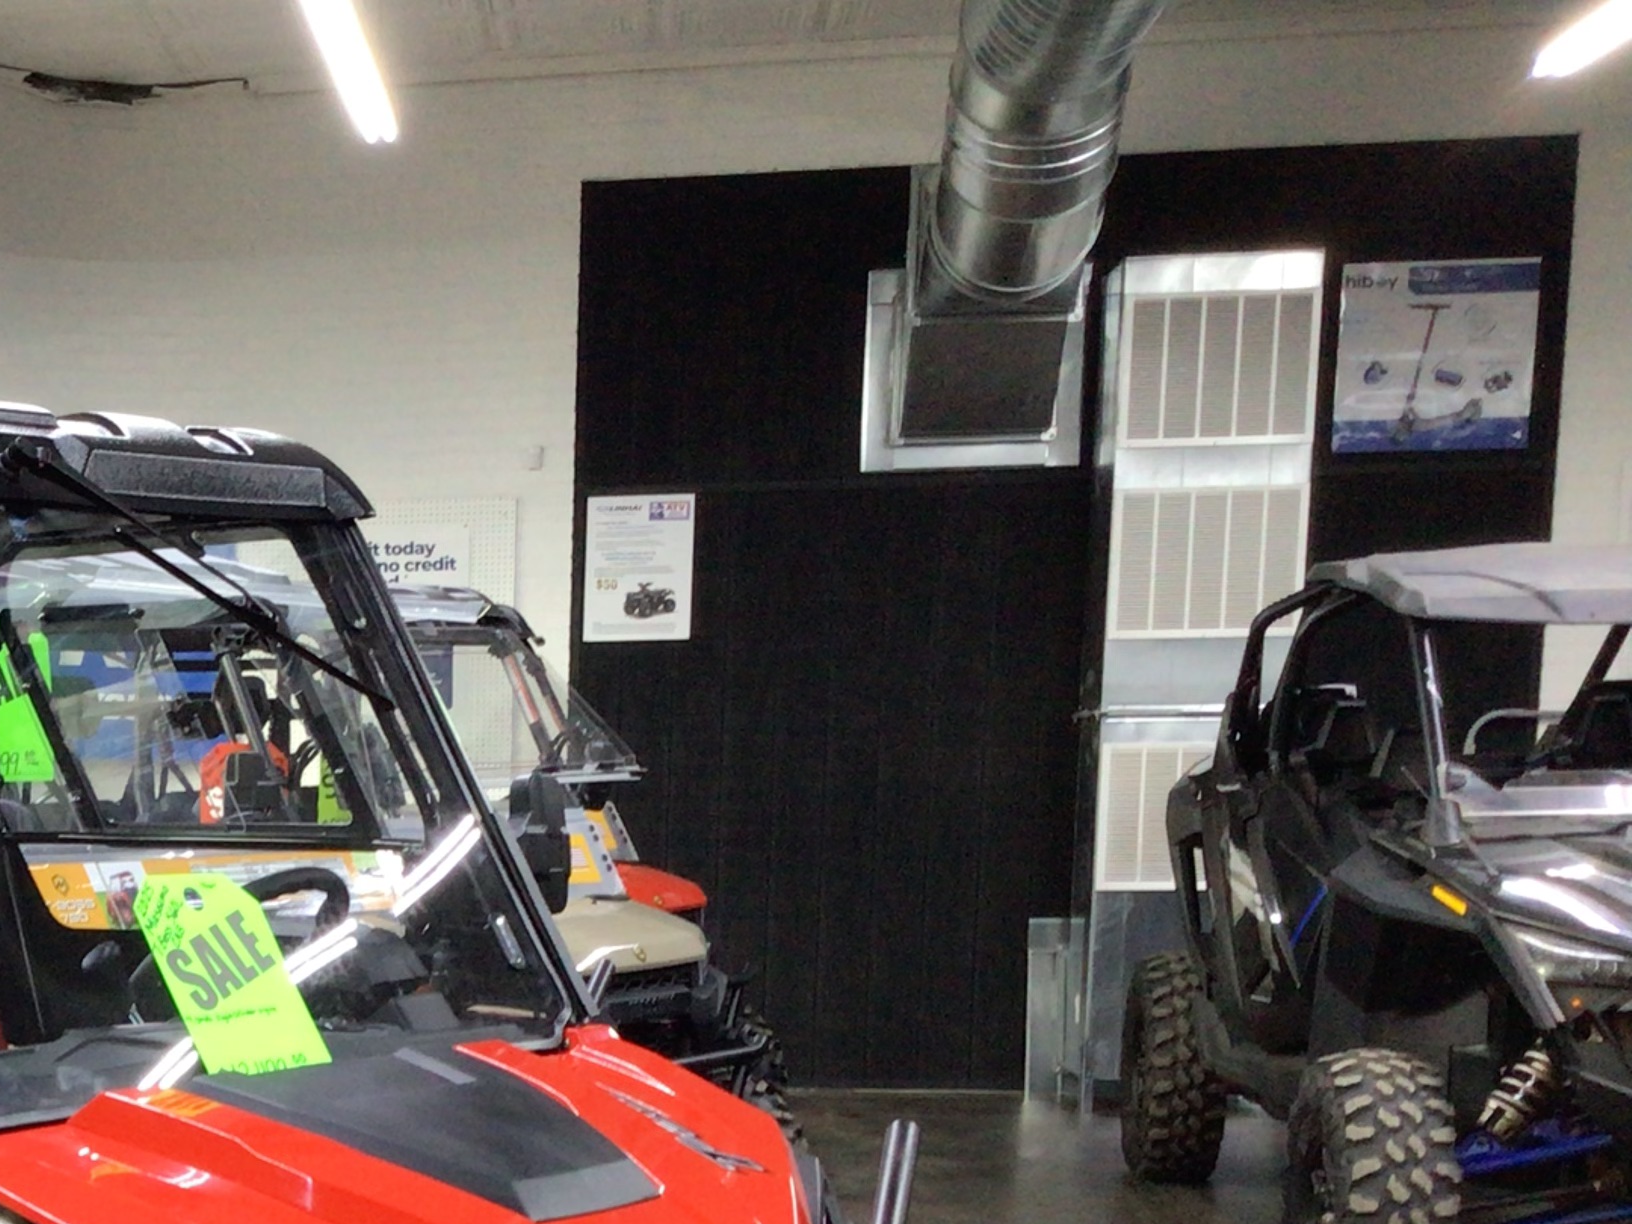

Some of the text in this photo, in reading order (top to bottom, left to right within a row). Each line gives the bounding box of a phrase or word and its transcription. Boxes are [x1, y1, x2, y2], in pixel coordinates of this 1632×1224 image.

[384, 541, 436, 558] today
[404, 555, 457, 572] credit
[166, 910, 275, 1010] SALE
